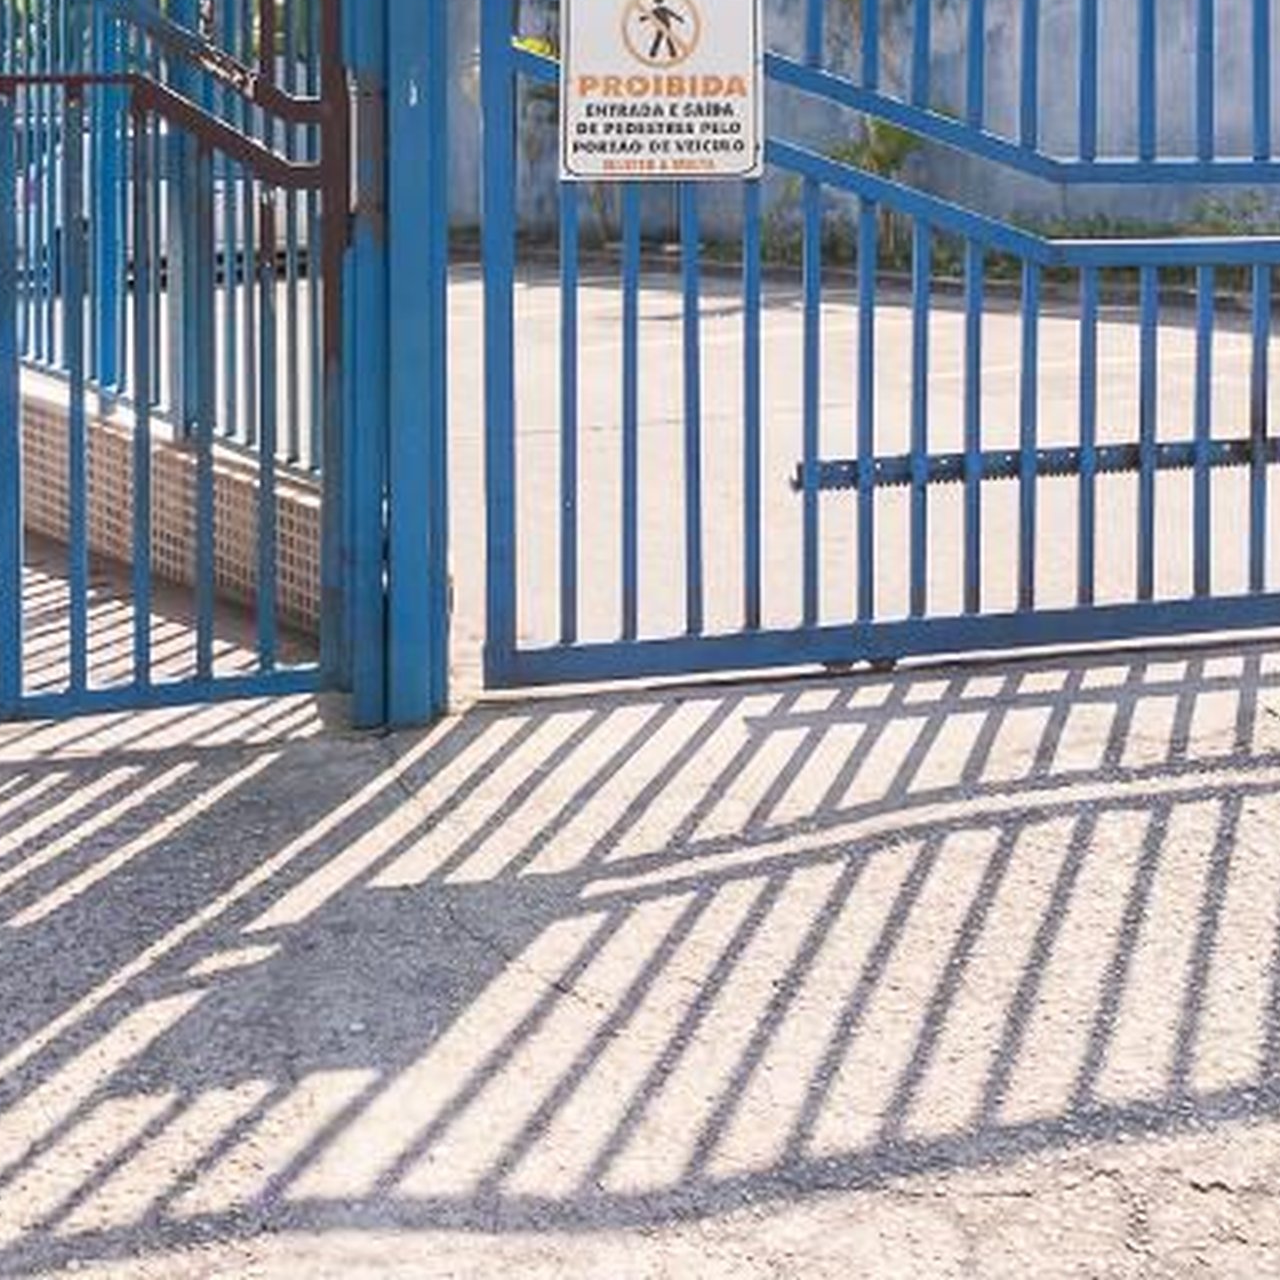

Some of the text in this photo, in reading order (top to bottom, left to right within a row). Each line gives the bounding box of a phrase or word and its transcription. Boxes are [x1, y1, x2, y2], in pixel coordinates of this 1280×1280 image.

[577, 75, 748, 98] PROIBIDA
[585, 103, 665, 118] ENTRADA
[670, 103, 680, 118] E
[576, 122, 598, 135] DE
[700, 122, 742, 135] PELO
[648, 139, 670, 154] DE
